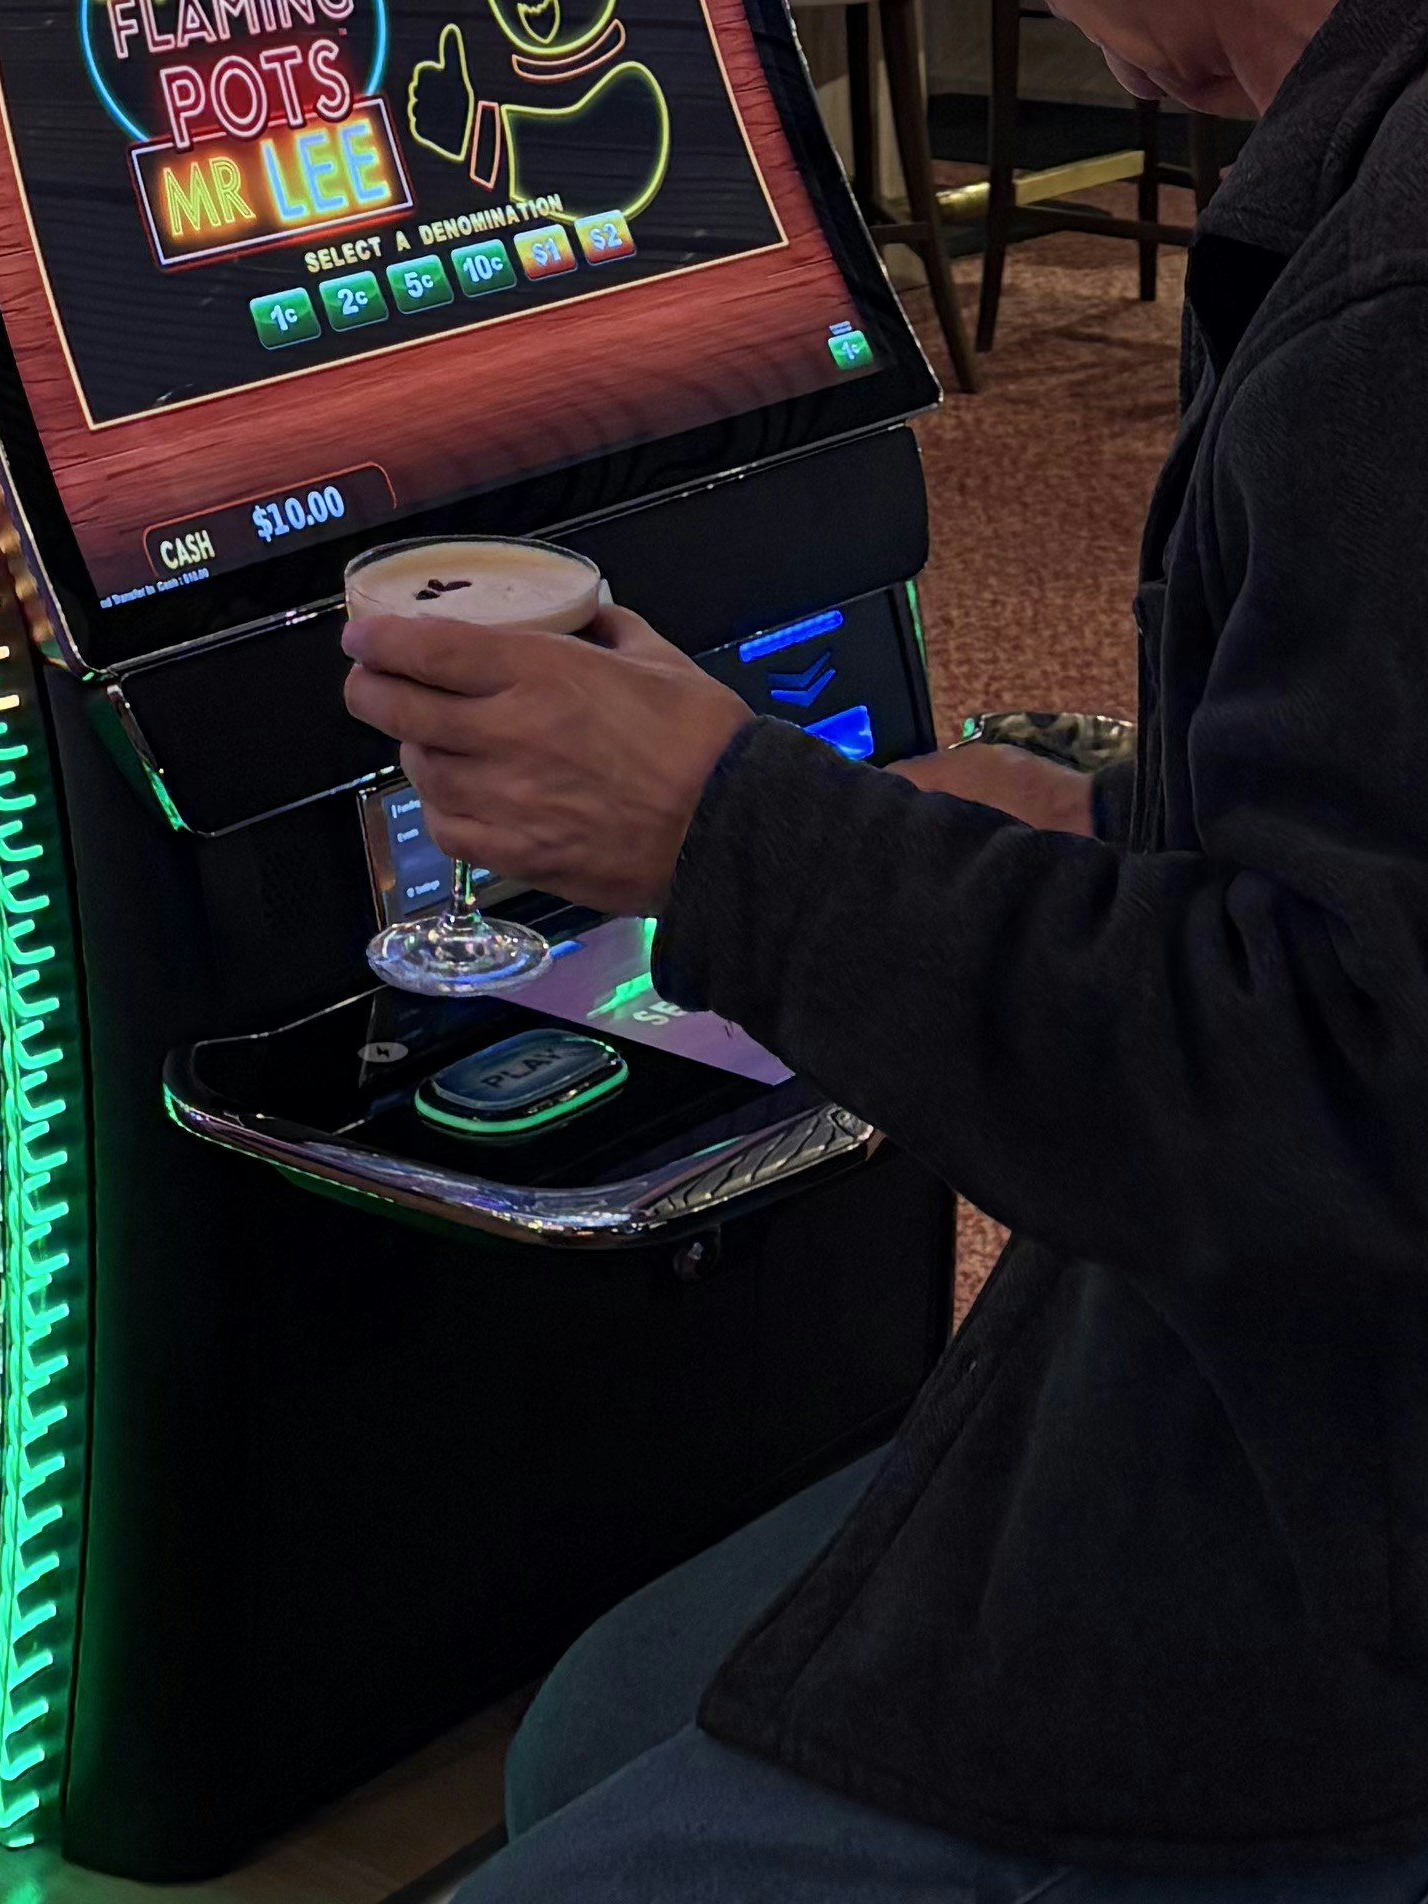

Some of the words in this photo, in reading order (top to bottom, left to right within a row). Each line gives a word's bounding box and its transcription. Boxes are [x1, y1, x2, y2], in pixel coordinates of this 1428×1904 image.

[159, 37, 352, 150] POTS
[161, 155, 257, 238] MR
[259, 120, 392, 224] LEE
[303, 236, 382, 274] SELECT
[395, 230, 411, 252] A
[418, 193, 565, 246] DENOMINATION
[529, 236, 562, 267] $1
[589, 221, 624, 251] $2
[252, 485, 346, 543] $10.00
[159, 529, 216, 570] CASH
[480, 1046, 563, 1090] PLAY
